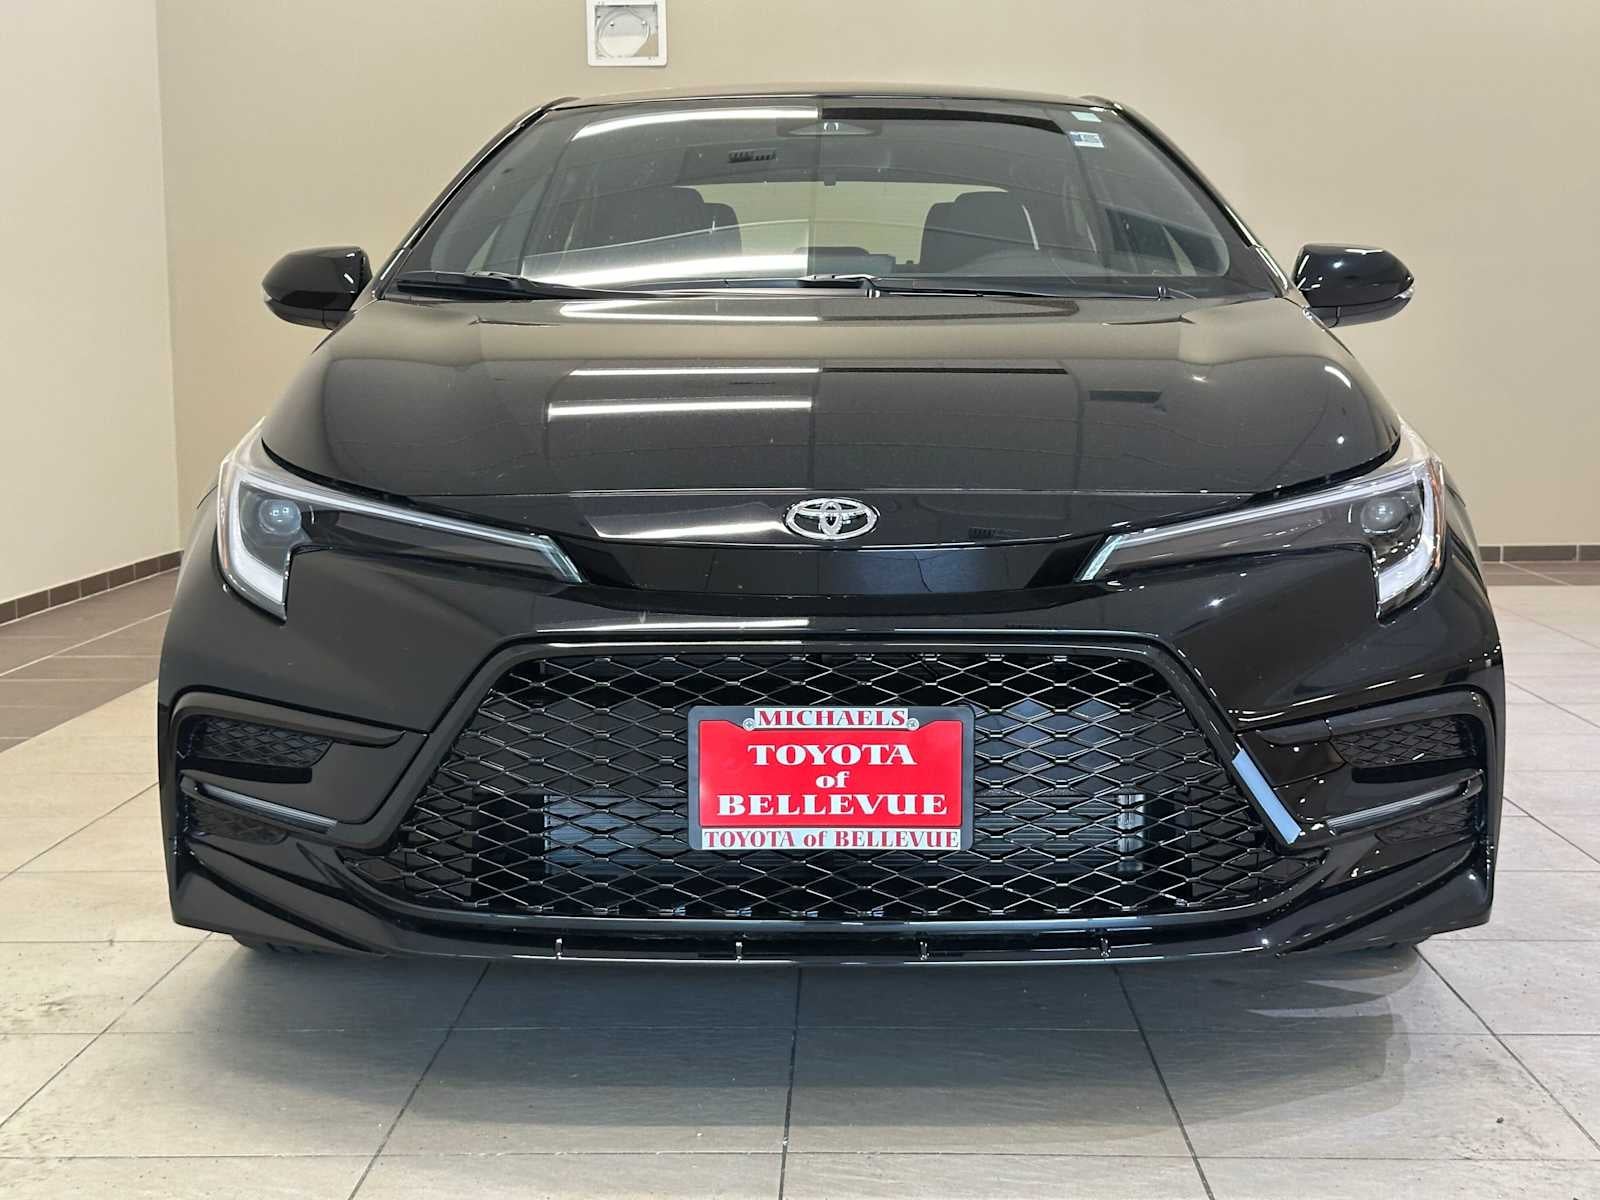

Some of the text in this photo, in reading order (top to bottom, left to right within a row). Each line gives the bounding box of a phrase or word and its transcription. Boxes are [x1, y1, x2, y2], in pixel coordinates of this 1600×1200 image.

[758, 710, 907, 726] MICHAELS
[747, 744, 917, 765] TOYOTA
[815, 771, 850, 788] of
[716, 794, 948, 816] BELLEVUE
[704, 831, 960, 848] TOYOTA of BELLEVUE
